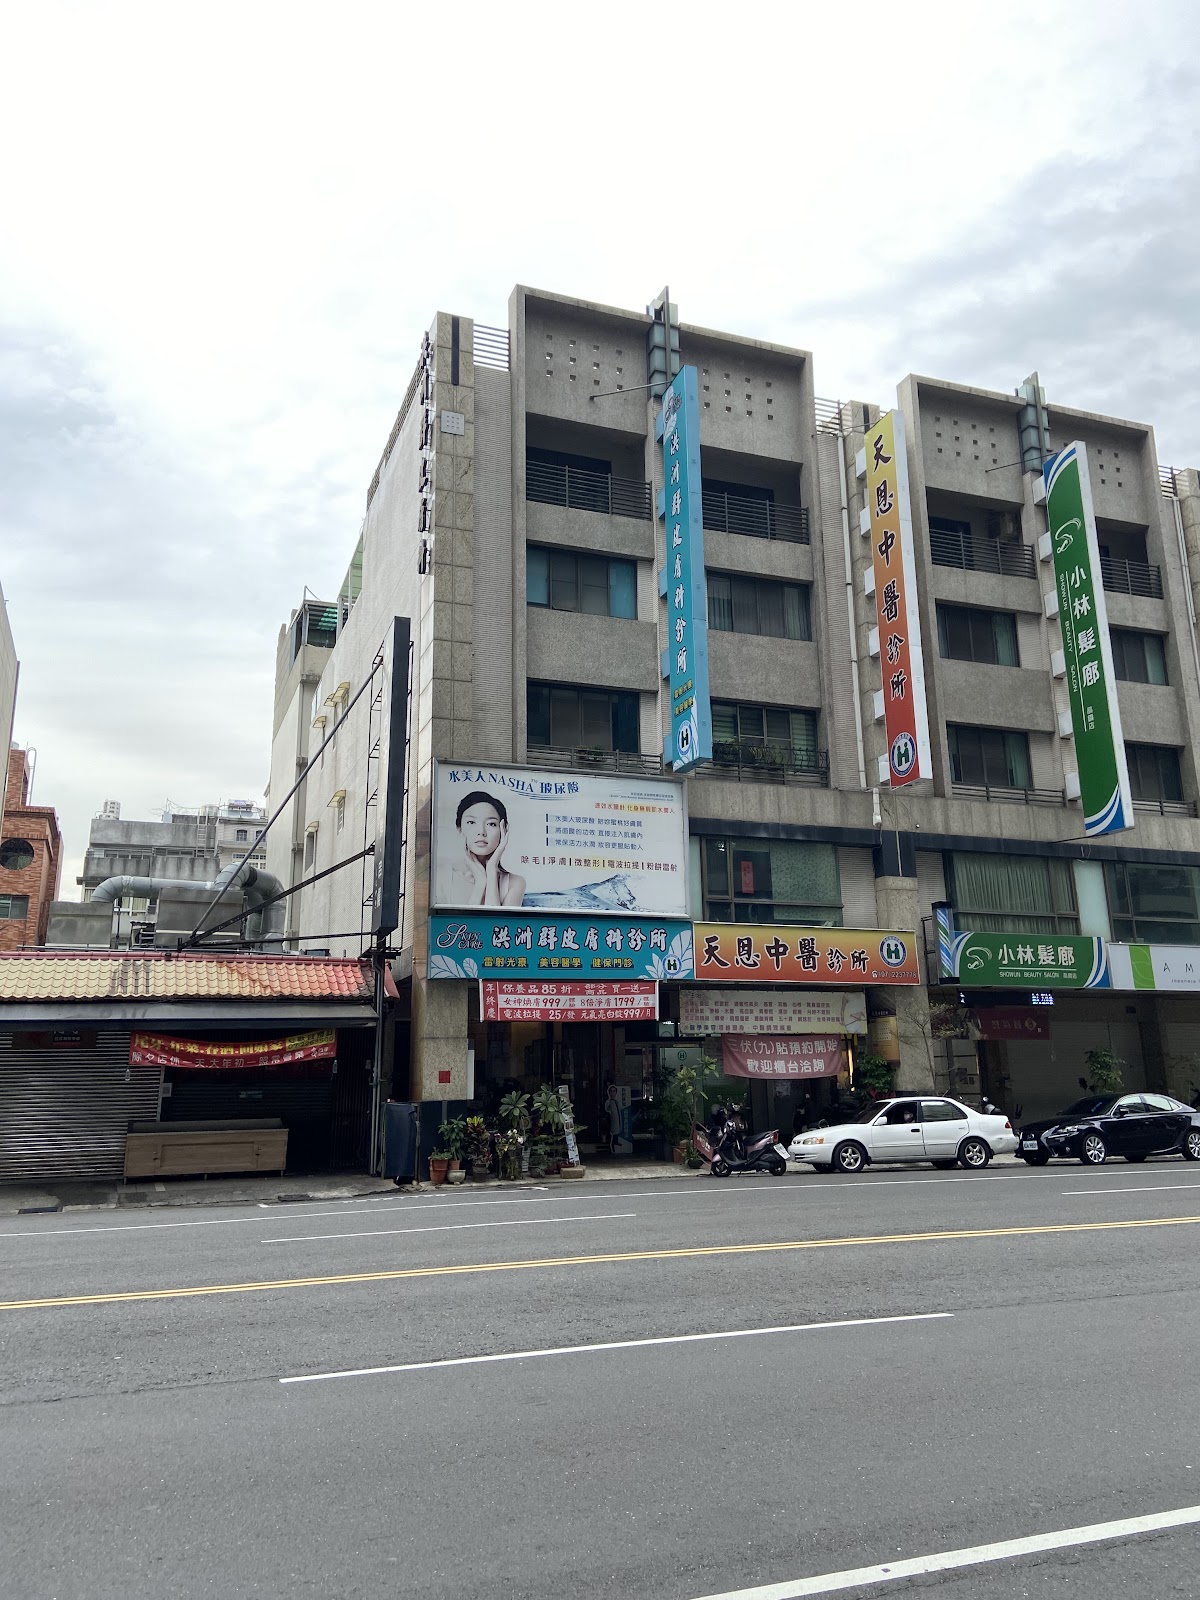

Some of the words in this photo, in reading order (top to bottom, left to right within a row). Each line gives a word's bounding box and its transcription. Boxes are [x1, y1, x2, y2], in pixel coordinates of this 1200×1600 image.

[872, 434, 907, 701] 天恩中醫診所
[1070, 565, 1100, 688] 小林髮廊
[1065, 620, 1073, 652] BEAUTY
[1070, 664, 1078, 693] SALON
[492, 926, 667, 952] 洪洲群皮膚科診所
[539, 956, 582, 968] 美容醫學
[592, 958, 633, 969] 健保門診
[700, 934, 869, 974] 天恩中醫診所
[998, 943, 1075, 966] 小林髮廊
[485, 983, 496, 1020] 年終慶
[612, 983, 650, 994] 買一送一
[503, 1009, 542, 1020] 電波拉提
[746, 1059, 825, 1074] 歡迎櫃台洽詢
